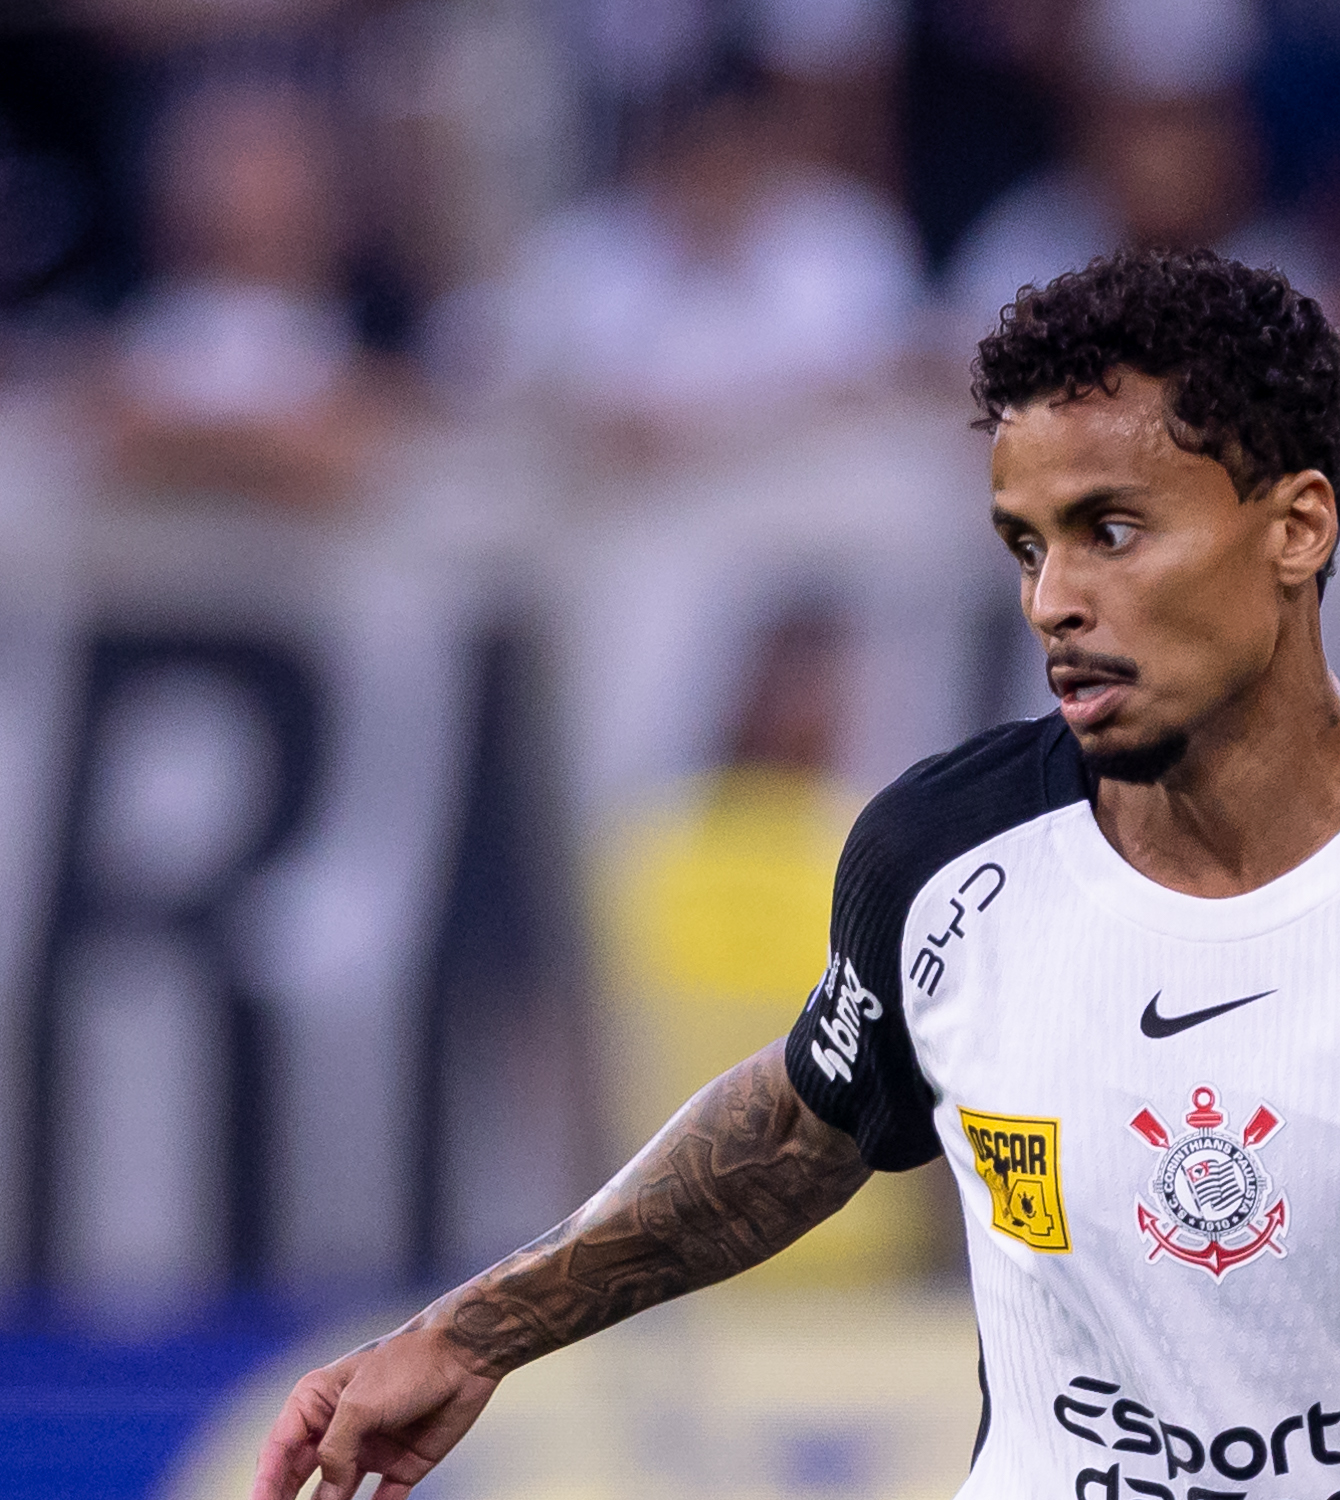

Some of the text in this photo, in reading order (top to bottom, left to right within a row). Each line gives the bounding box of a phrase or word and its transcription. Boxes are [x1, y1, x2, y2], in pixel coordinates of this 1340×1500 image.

[909, 862, 1007, 997] BYD
[967, 1124, 1047, 1176] OSCAR
[1163, 1137, 1233, 1194] CORINTHIANS
[1231, 1149, 1257, 1215] PAULISTA
